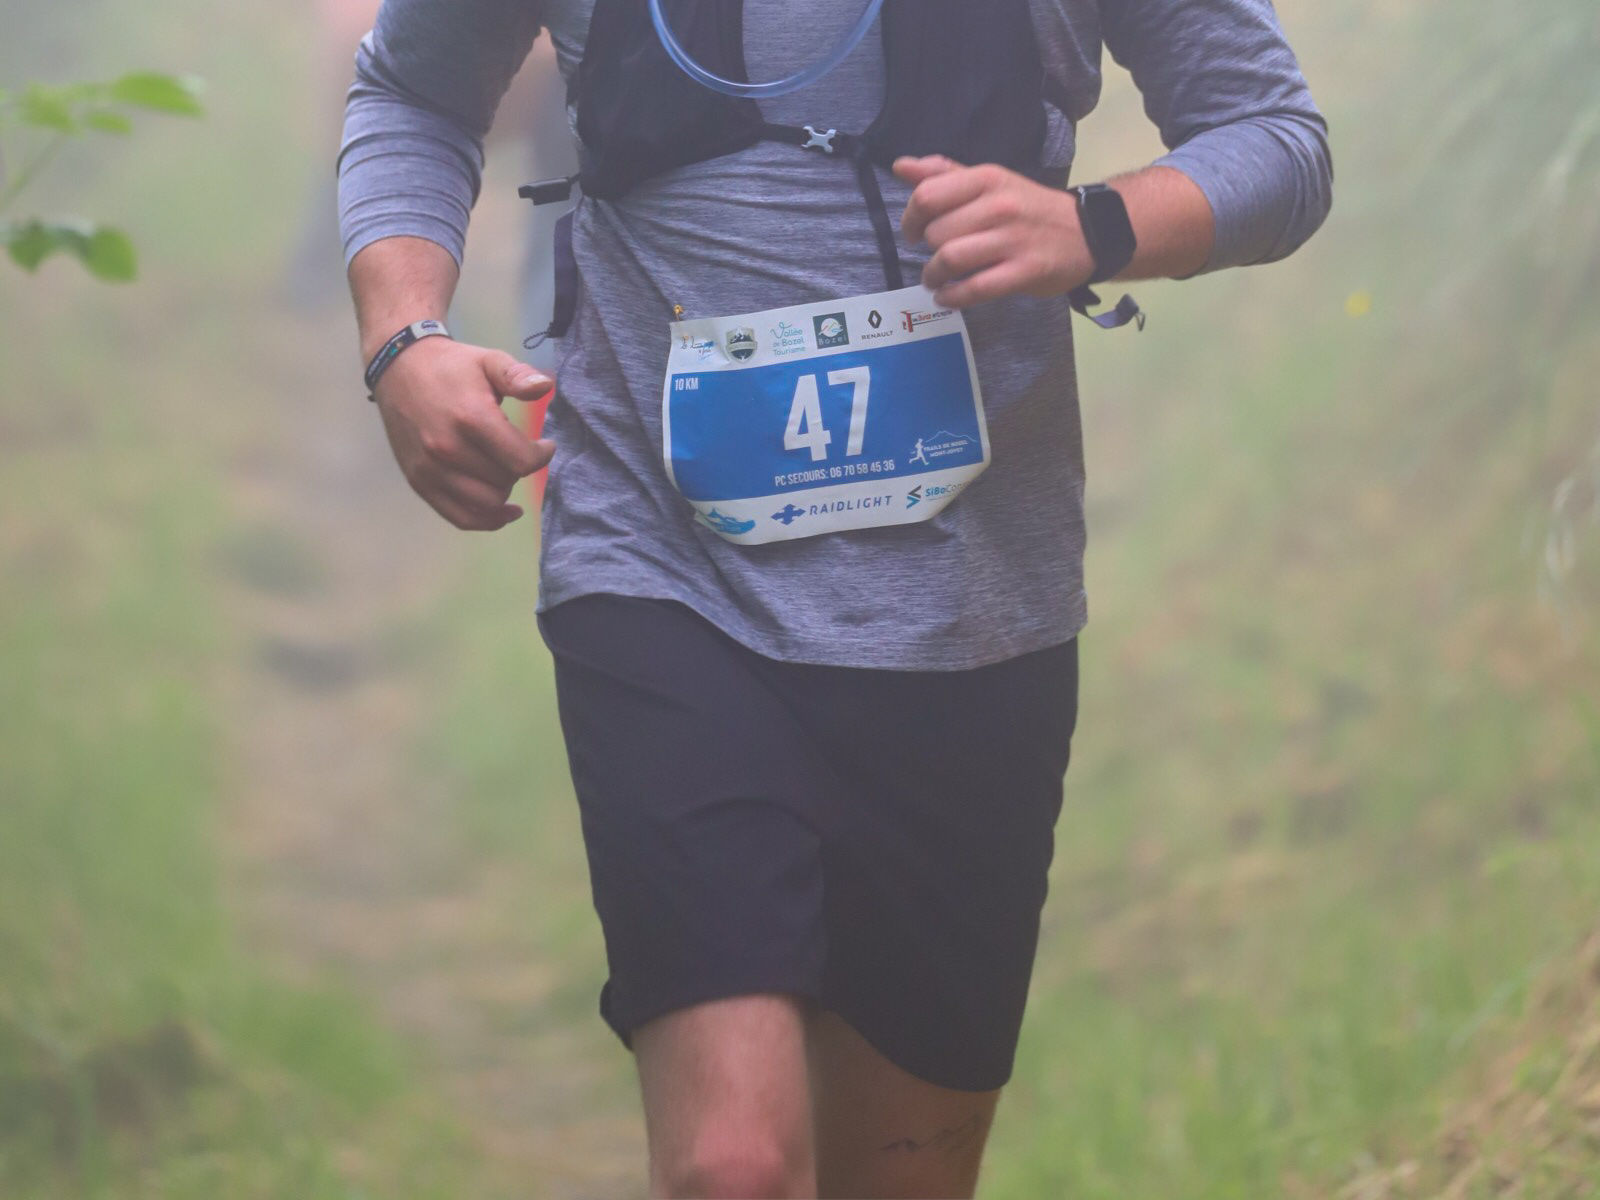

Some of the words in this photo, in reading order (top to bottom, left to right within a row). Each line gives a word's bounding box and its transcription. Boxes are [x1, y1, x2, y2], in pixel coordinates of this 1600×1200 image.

[770, 321, 803, 339] Vallée
[861, 330, 893, 340] RENAULT
[782, 336, 805, 347] Bozel
[818, 334, 848, 346] Bozel
[772, 346, 806, 356] Tourisme
[675, 378, 685, 391] 10
[685, 377, 699, 391] KM
[784, 366, 871, 462] 47
[774, 475, 787, 487] PC
[787, 468, 829, 485] SECOURS:
[829, 466, 842, 478] 06
[843, 464, 855, 476] 70
[856, 462, 869, 475] 58
[870, 461, 881, 473] 45
[883, 459, 895, 471] 36
[809, 495, 893, 516] RAIDLIGHT
